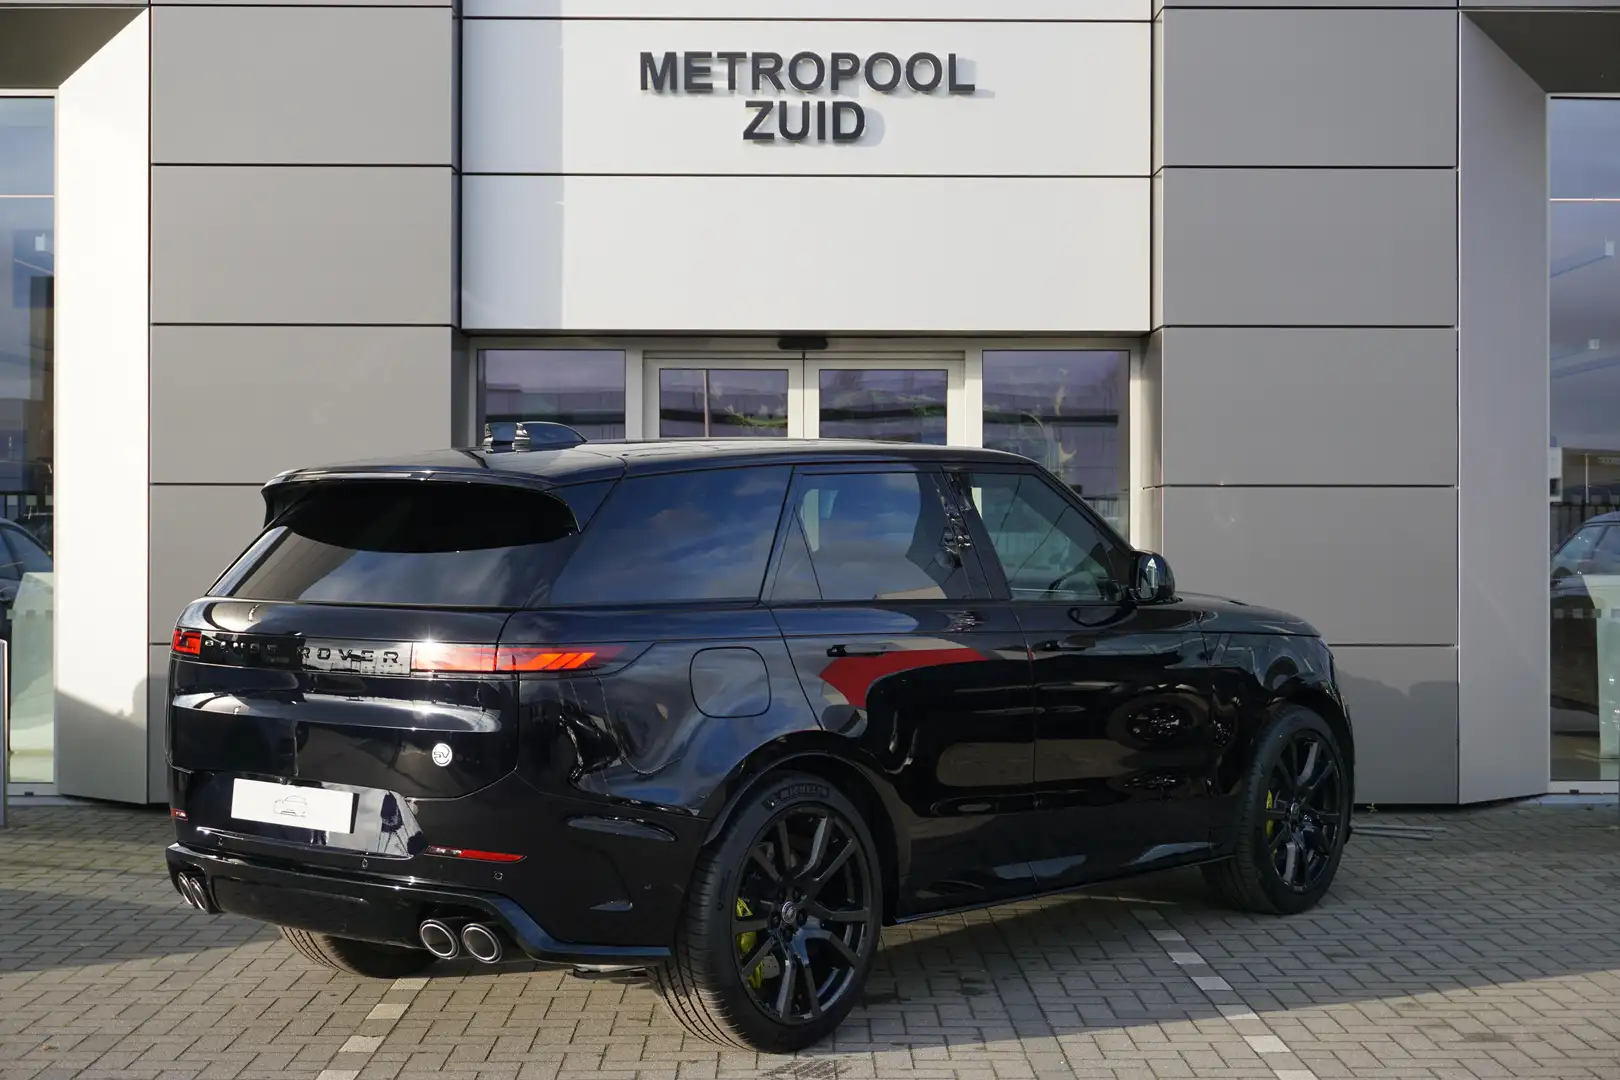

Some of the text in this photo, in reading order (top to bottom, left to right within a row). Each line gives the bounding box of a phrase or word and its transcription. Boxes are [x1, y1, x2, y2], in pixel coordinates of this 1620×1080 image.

[640, 51, 976, 92] METROPOOL
[743, 100, 865, 141] ZUID
[298, 647, 399, 664] ROVER
